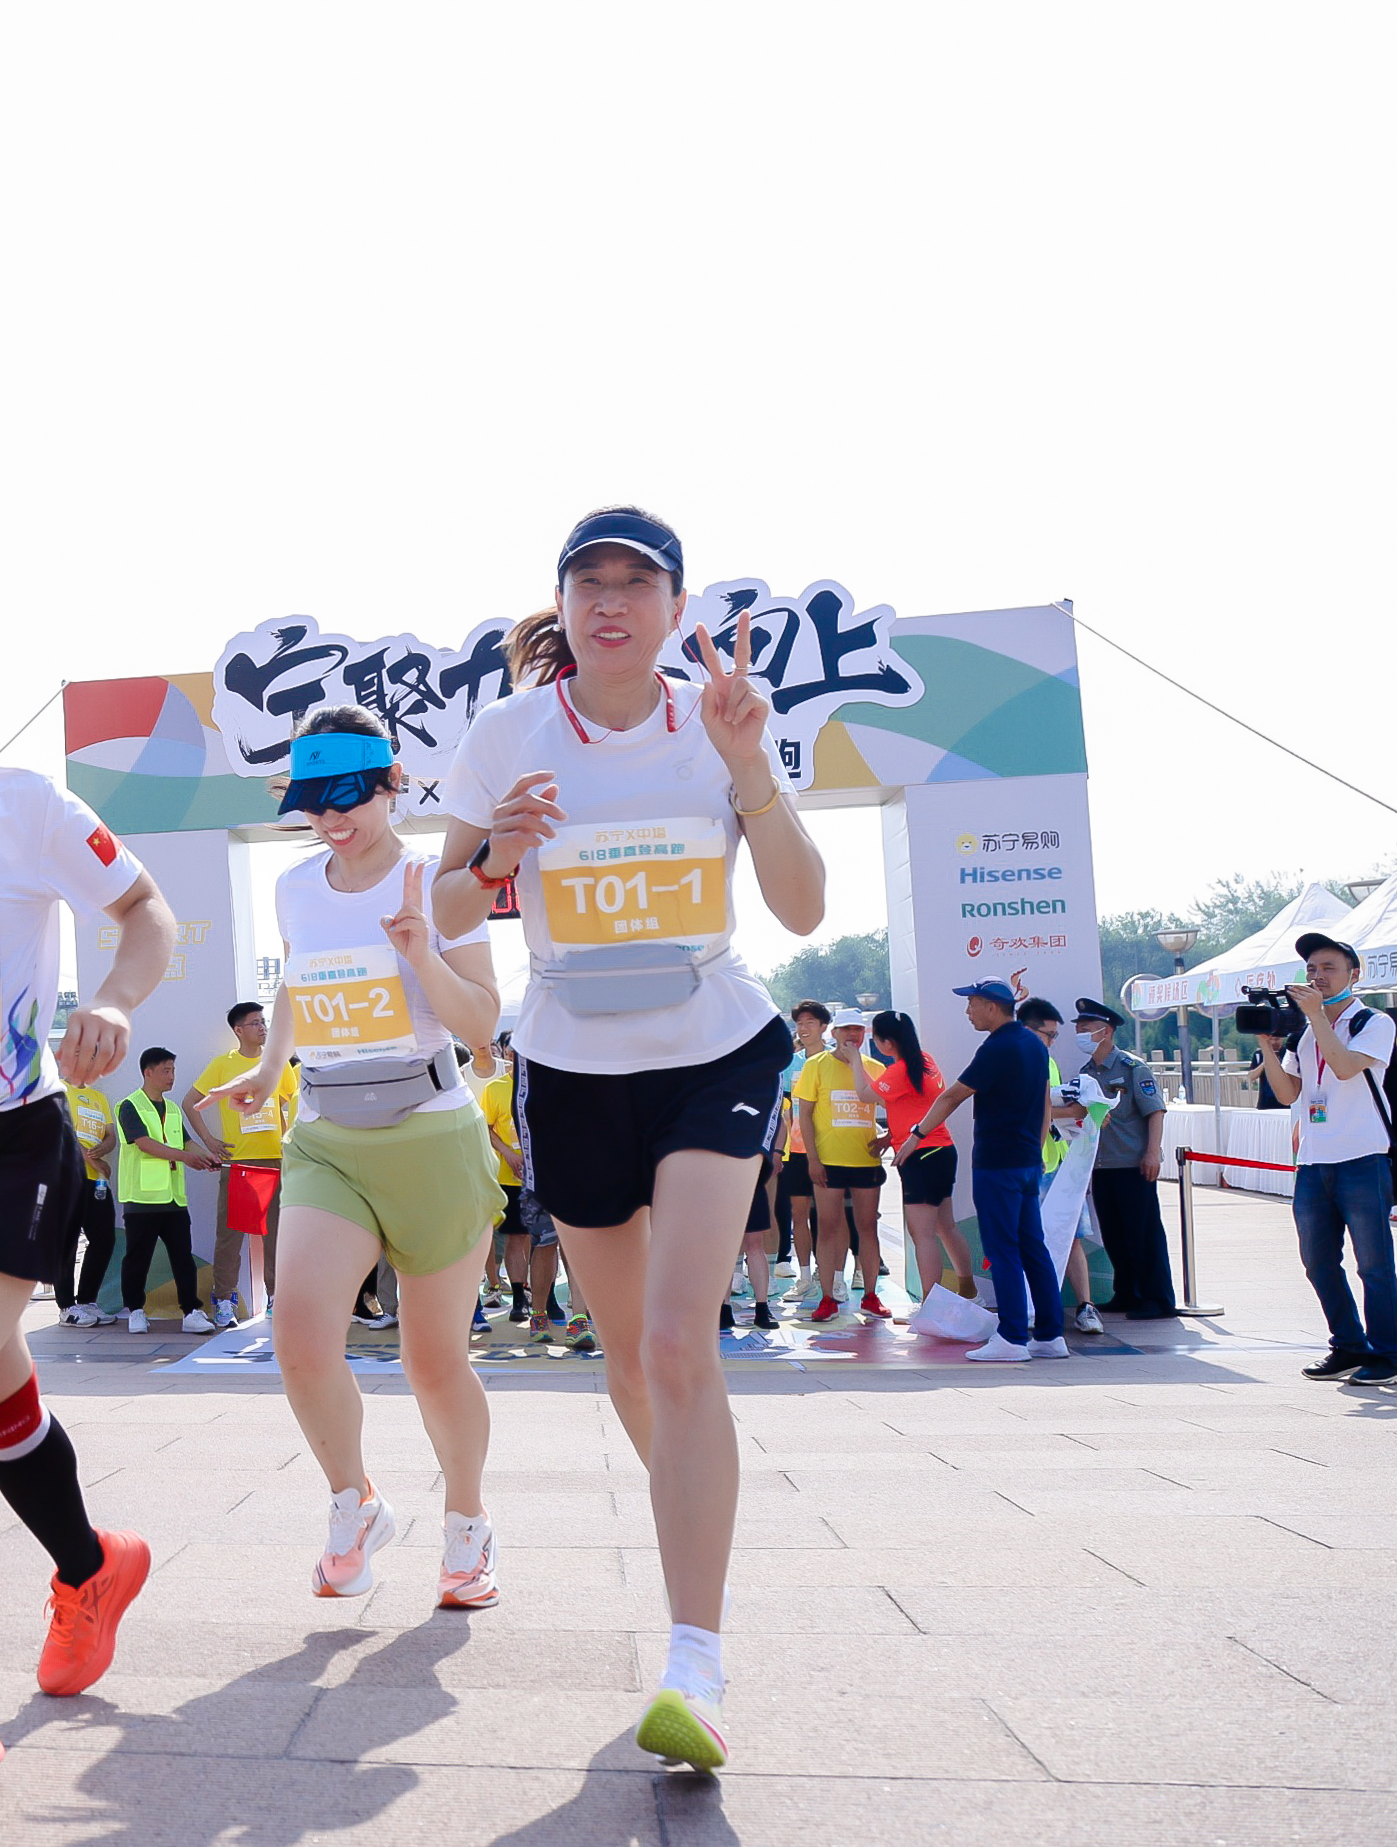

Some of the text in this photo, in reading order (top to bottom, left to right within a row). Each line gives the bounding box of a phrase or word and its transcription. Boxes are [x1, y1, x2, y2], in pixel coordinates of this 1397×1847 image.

[982, 831, 1061, 852] 苏宁易购
[579, 843, 685, 861] 618垂直登高跑
[959, 867, 1063, 884] Hisense
[561, 868, 703, 914] T01-1
[961, 897, 1066, 918] Ronshen
[614, 917, 660, 934] 团体组
[989, 935, 1067, 951] 奇欢集团
[301, 967, 368, 982] 618垂直登高跑
[295, 987, 395, 1023] T01-2
[833, 1102, 871, 1114] T02-4
